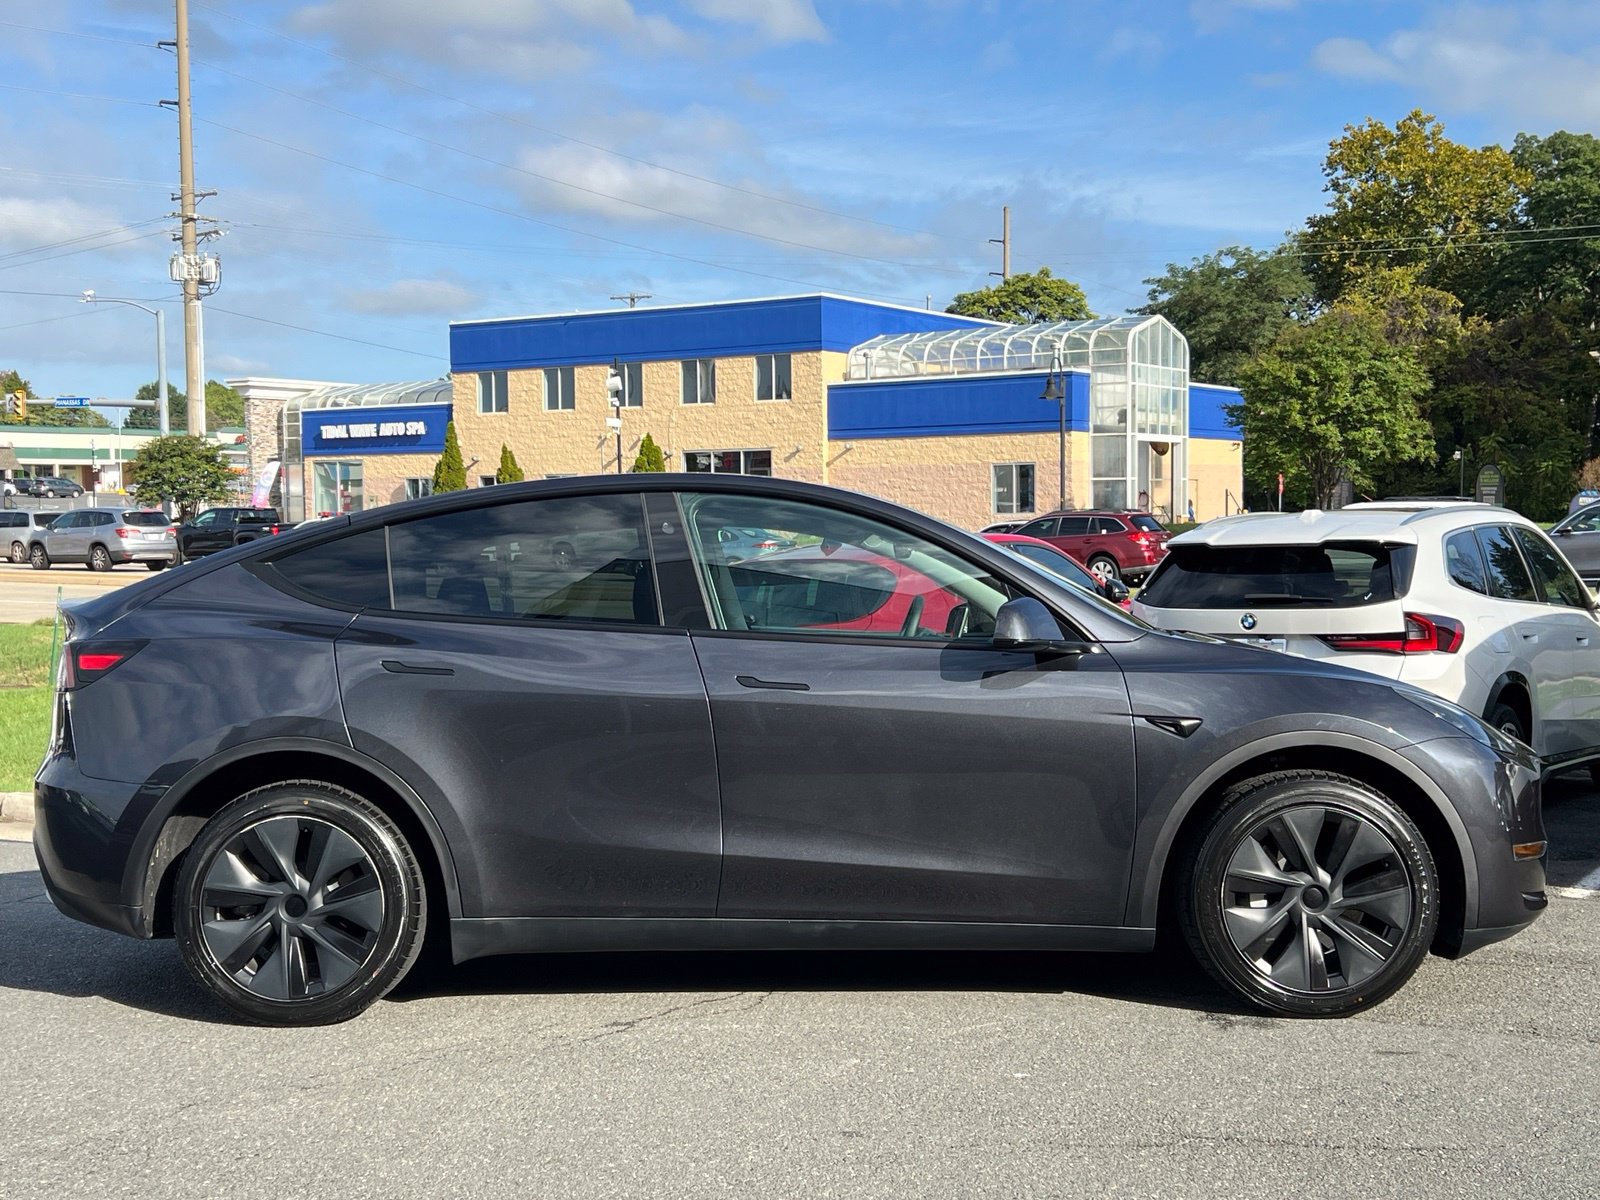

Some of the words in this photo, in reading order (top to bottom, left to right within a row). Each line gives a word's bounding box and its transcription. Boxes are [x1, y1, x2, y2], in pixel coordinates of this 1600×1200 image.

[320, 424, 349, 439] TIDAL
[349, 423, 377, 438] WAVE
[379, 422, 405, 437] AUTO
[406, 421, 426, 436] SPA
